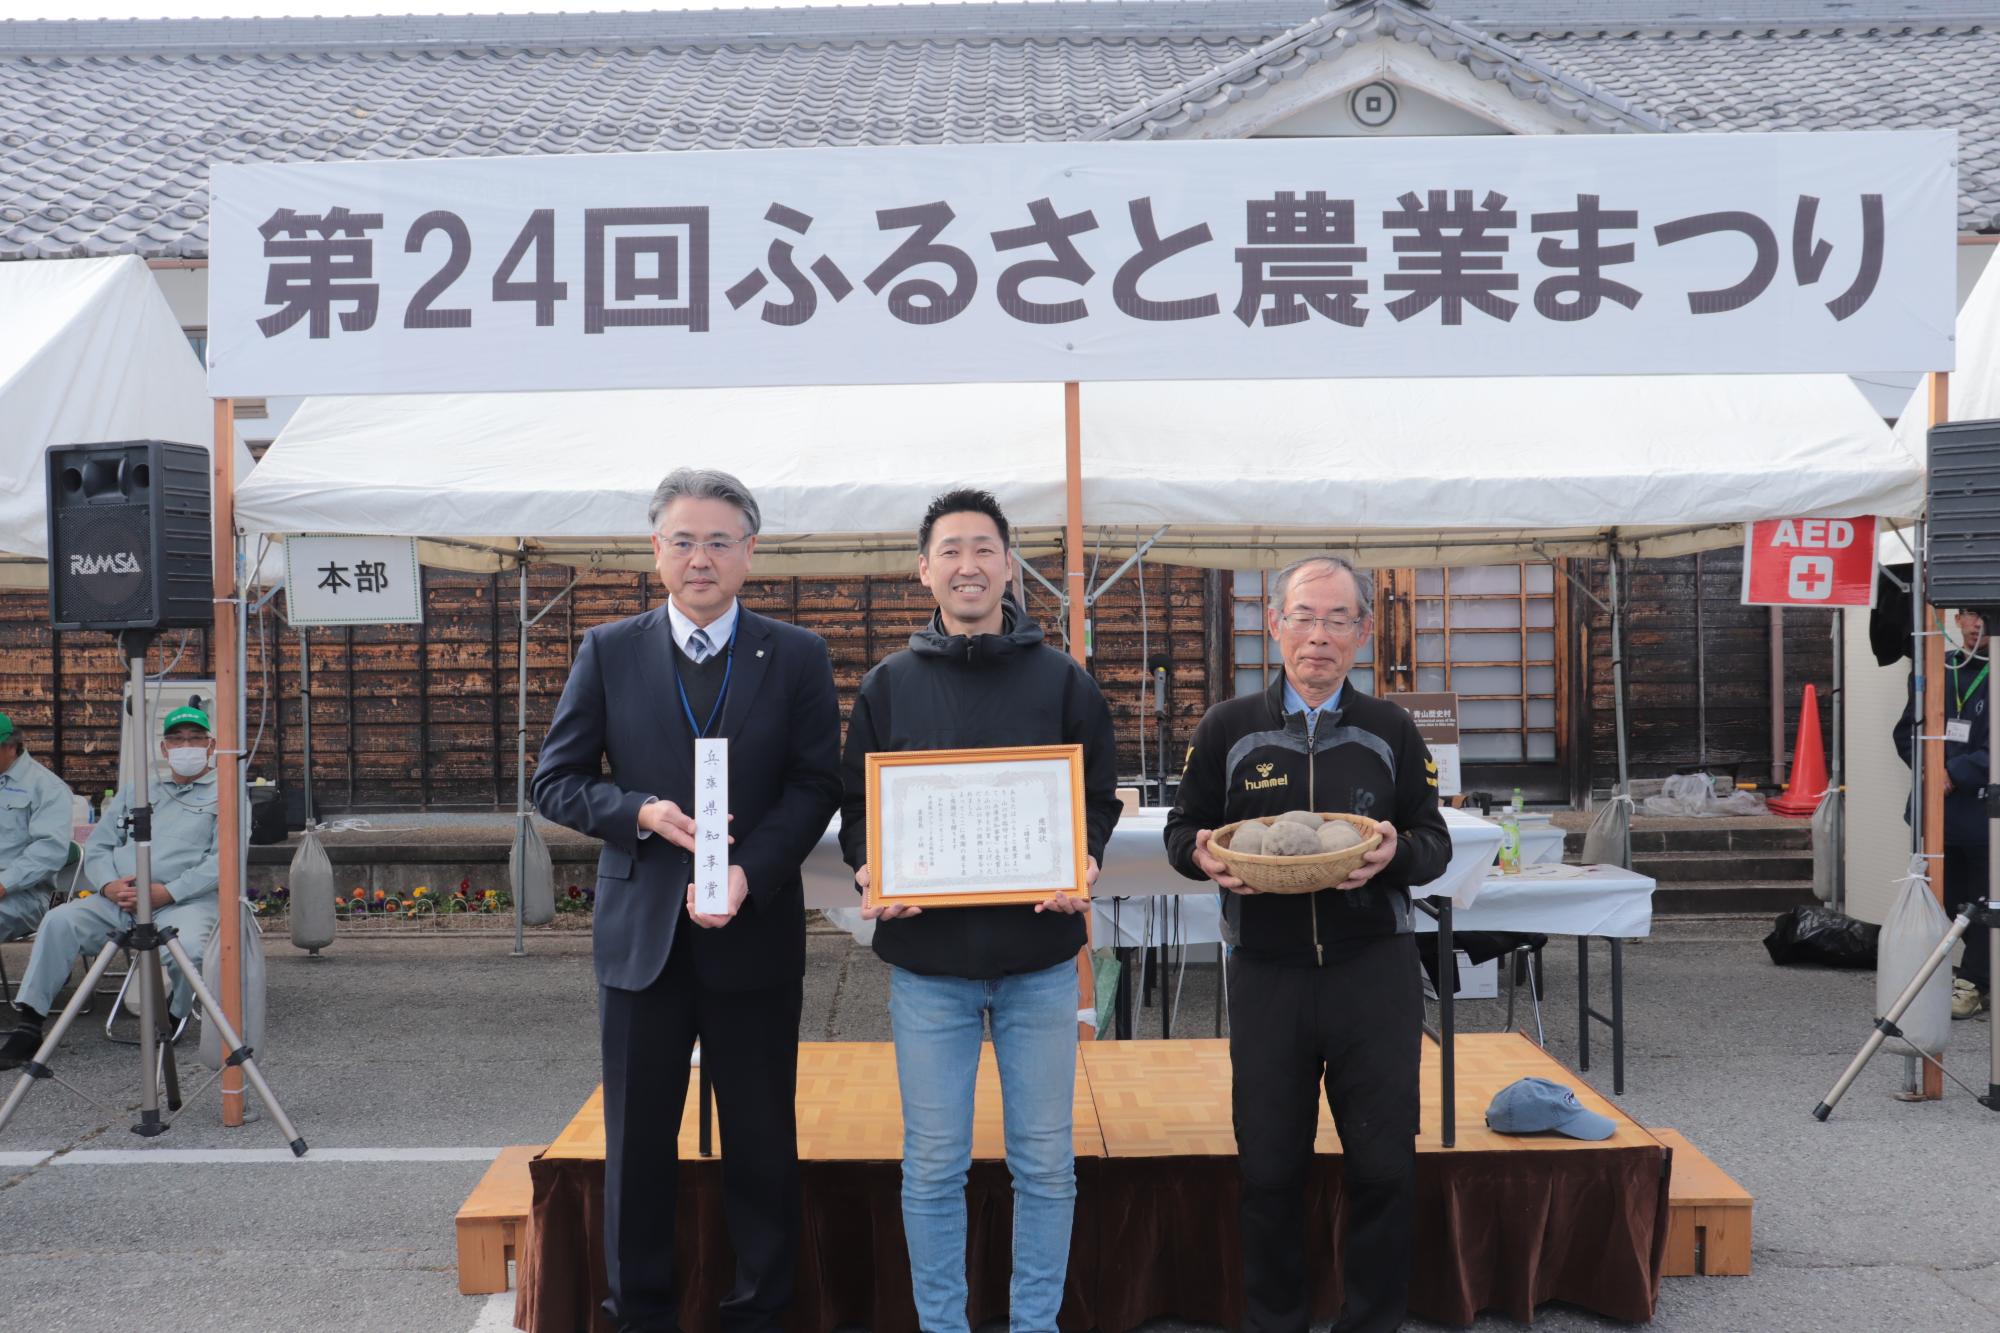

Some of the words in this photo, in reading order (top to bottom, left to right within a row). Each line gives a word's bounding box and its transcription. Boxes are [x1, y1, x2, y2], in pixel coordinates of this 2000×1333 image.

[256, 189, 1884, 339] 第24回ふるさと農業まつり
[1770, 519, 1854, 548] AED
[70, 551, 142, 575] RAMSA
[317, 560, 388, 594] 本部
[1413, 709, 1451, 718] 青山歴史村
[1245, 774, 1288, 790] hummel
